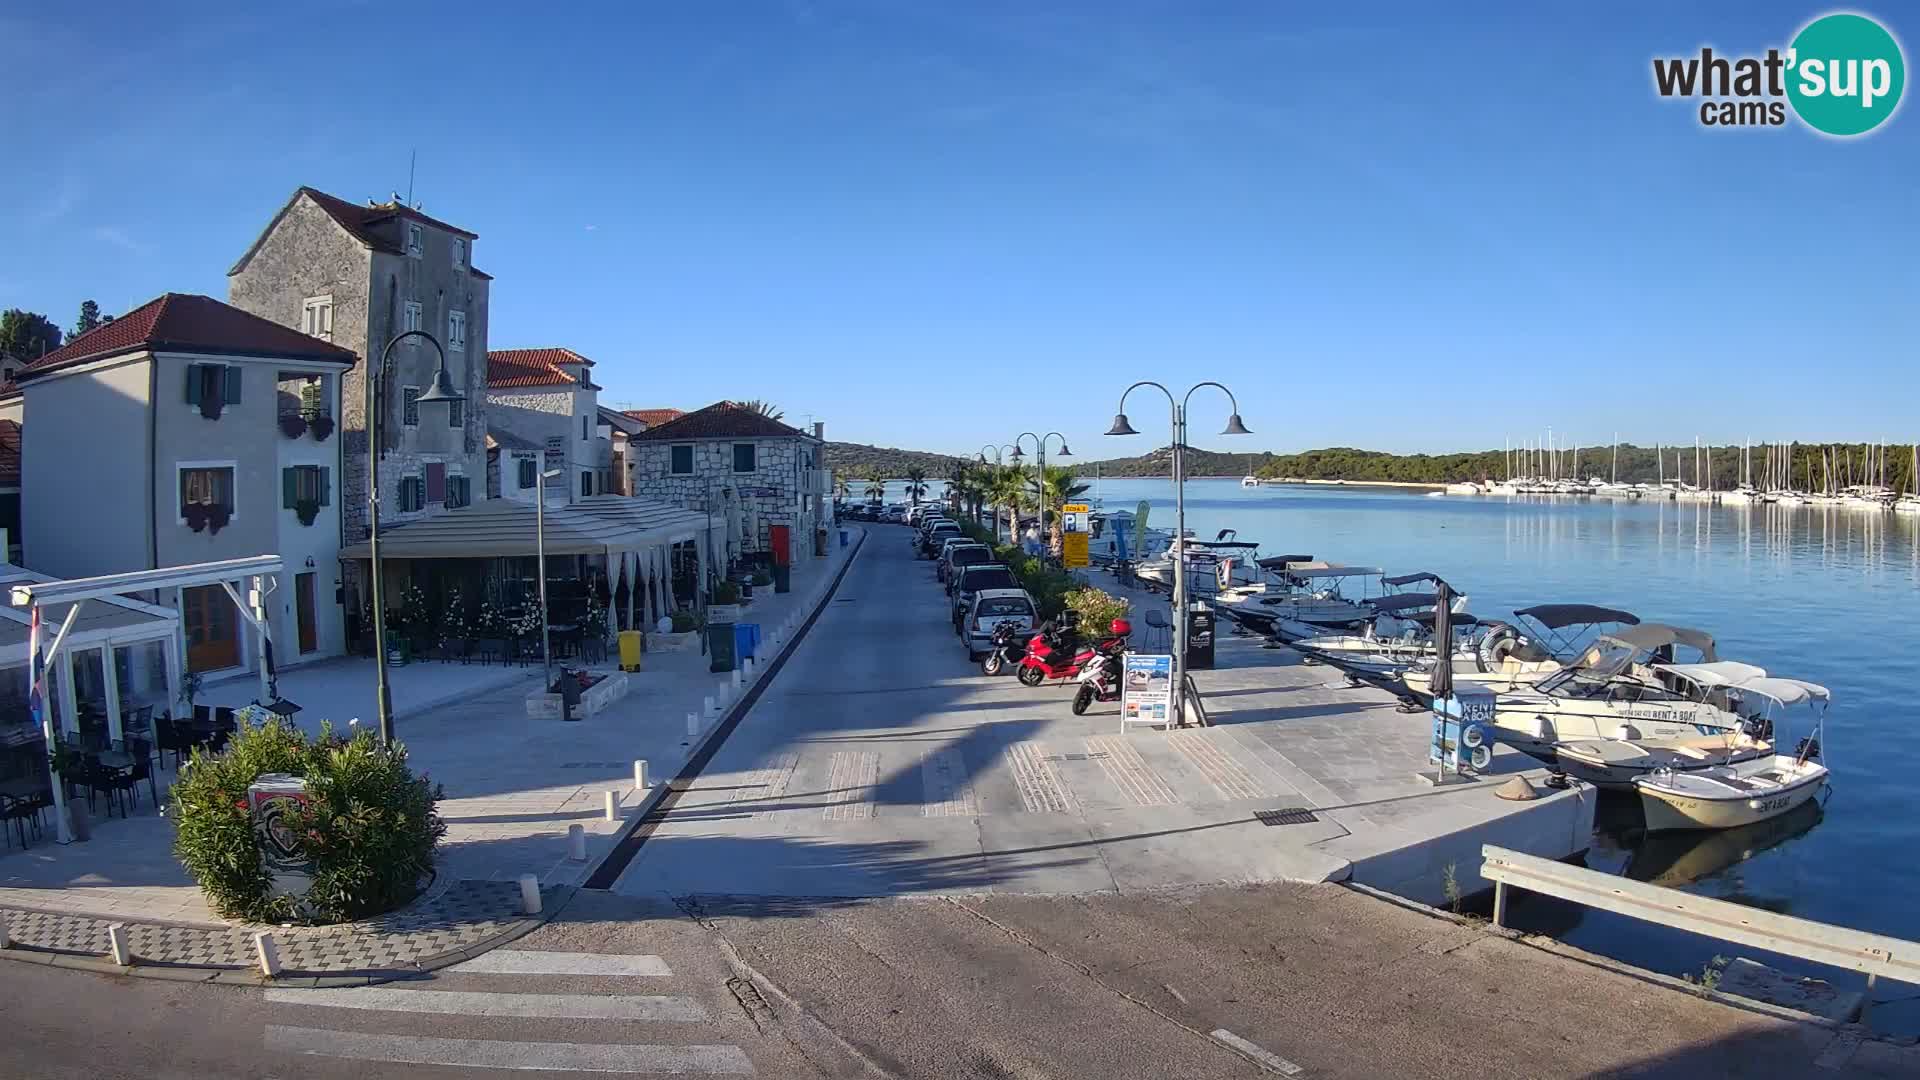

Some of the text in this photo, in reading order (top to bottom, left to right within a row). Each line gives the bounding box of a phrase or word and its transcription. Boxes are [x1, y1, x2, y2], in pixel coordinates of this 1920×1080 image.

[1065, 514, 1076, 530] P
[1463, 703, 1493, 713] RENT
[1462, 711, 1494, 721] A BOAT
[1652, 710, 1671, 720] RENT
[1672, 711, 1678, 720] A
[1680, 711, 1696, 722] BOAT
